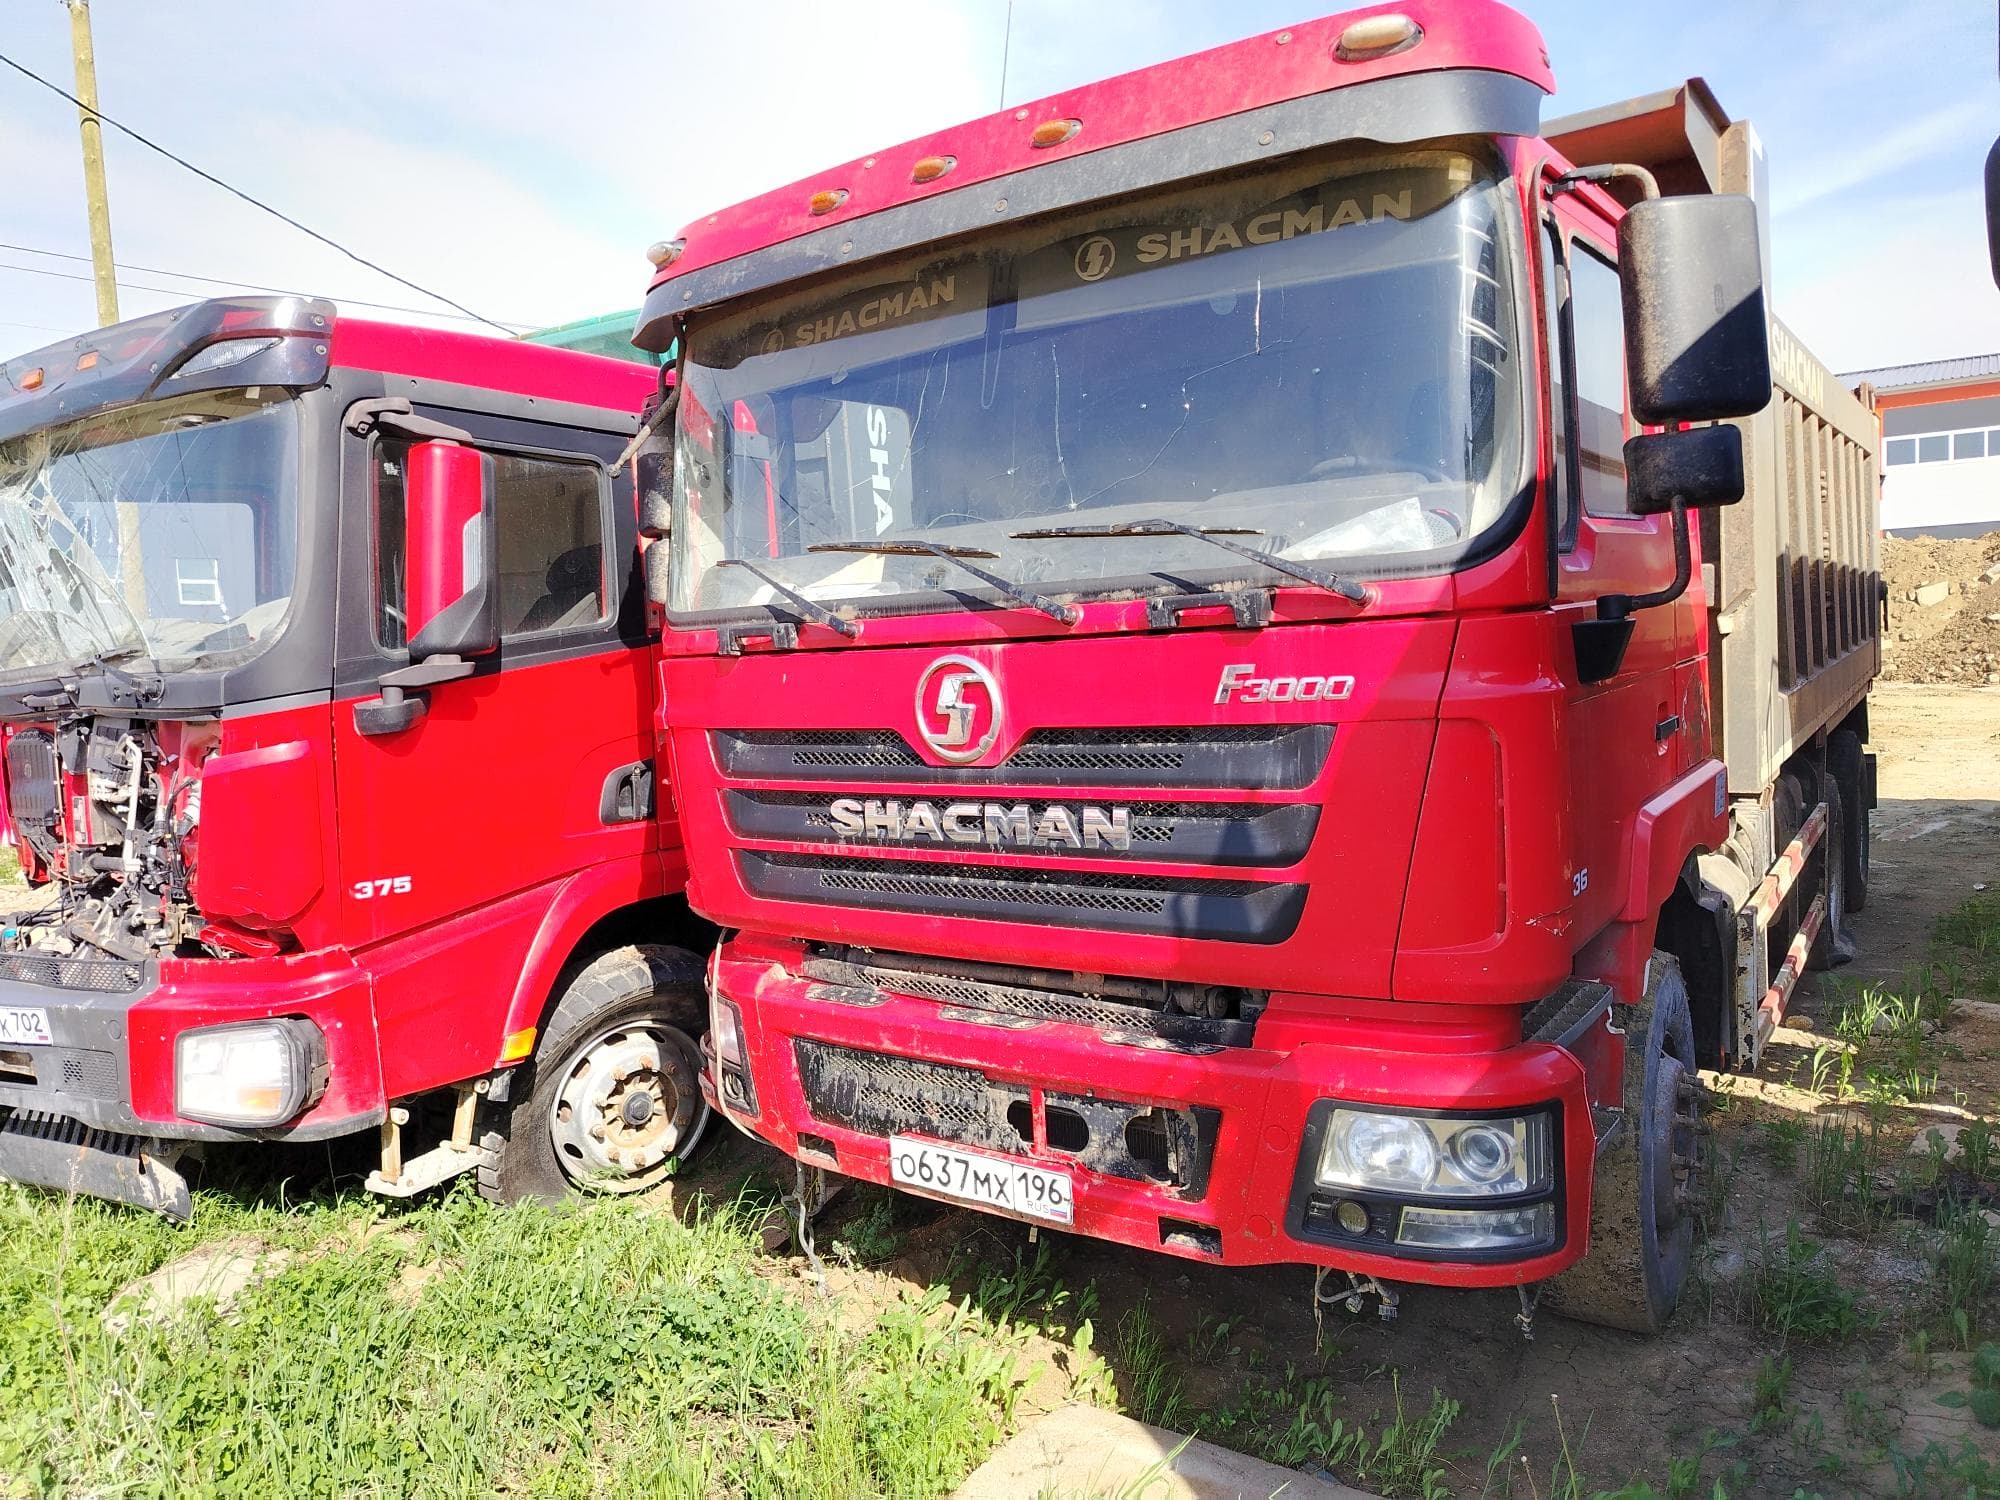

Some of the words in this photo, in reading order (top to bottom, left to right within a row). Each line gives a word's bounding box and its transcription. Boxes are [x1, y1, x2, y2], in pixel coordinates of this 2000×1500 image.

[1136, 189, 1412, 264] SHACMAN
[795, 275, 956, 348] SHACMAN
[1213, 663, 1356, 705] F3000
[830, 798, 1133, 850] SHACMAN
[353, 875, 412, 900] 375
[10, 1012, 43, 1032] 702
[1017, 1172, 1064, 1205] 196
[1027, 1201, 1050, 1213] RUS
